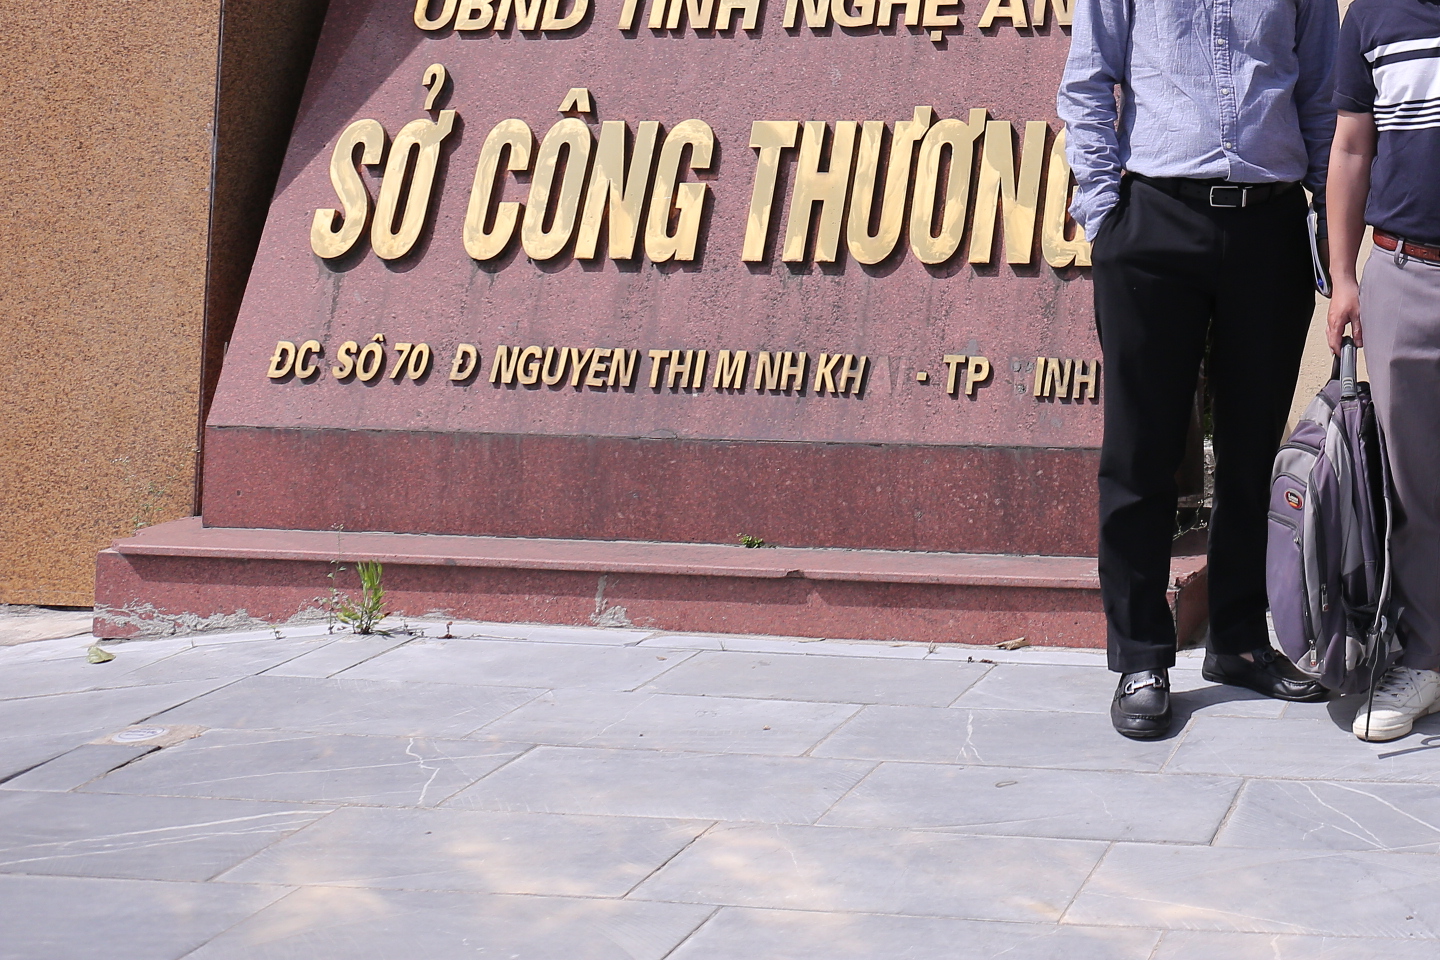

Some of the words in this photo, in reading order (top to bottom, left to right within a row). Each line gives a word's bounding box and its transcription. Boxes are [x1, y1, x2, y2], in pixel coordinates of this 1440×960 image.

[310, 63, 456, 261] SỞ
[462, 87, 716, 262] CÔNG
[741, 105, 1093, 268] THƯƠNG
[266, 339, 321, 380] ĐC
[388, 342, 430, 380] 70
[449, 345, 478, 382] Đ
[488, 344, 638, 387] NGUYEN
[648, 349, 707, 389] THI
[943, 354, 990, 395] TP
